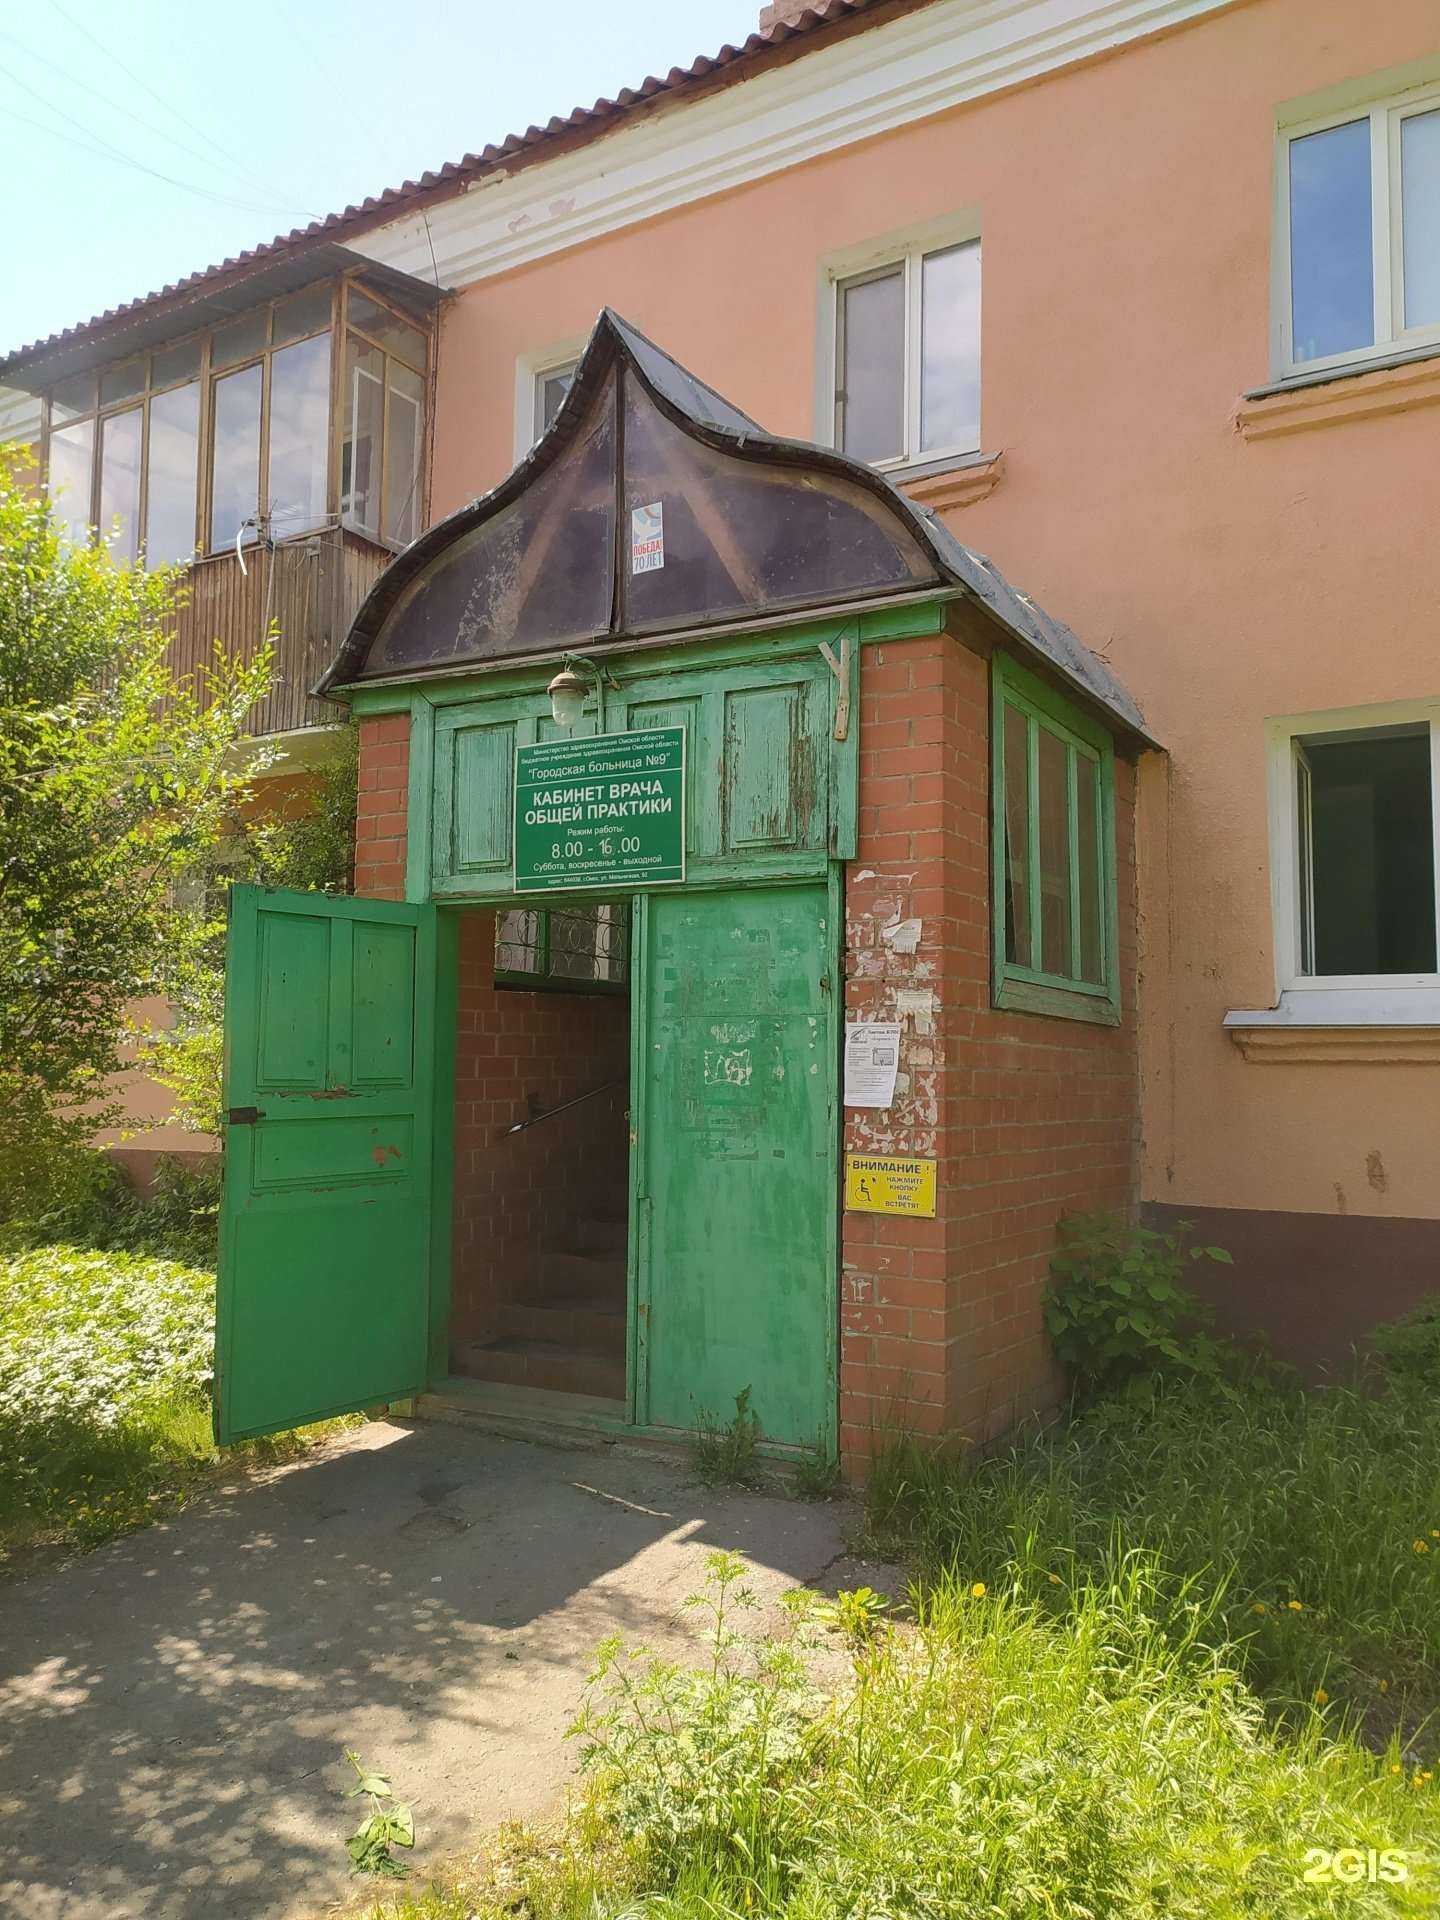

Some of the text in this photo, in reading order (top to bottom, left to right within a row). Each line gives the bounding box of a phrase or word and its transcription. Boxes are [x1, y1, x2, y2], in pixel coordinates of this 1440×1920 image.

[634, 552, 661, 571] 70 ЛЕТ
[533, 733, 664, 755] Министерство здравоохранения Омской области
[632, 742, 654, 751] Омской
[655, 739, 678, 748] области
[588, 757, 642, 773] больница
[533, 779, 664, 806] КАБИНЕТ ВРАЧА
[525, 797, 672, 825] ОБЩЕЙ ПРАКТИКИ
[567, 824, 624, 837] Режим работы:
[551, 841, 583, 859] 8.00
[533, 861, 566, 873] Суббота,
[568, 859, 616, 870] воскресенье
[623, 854, 662, 866] выходной
[852, 1160, 921, 1174] ВНИМАНИЕ
[886, 1176, 925, 1185] НАЖМИТЕ
[889, 1184, 918, 1192] КНОПКУ
[885, 1200, 920, 1209] ВСТРЕТЯТ
